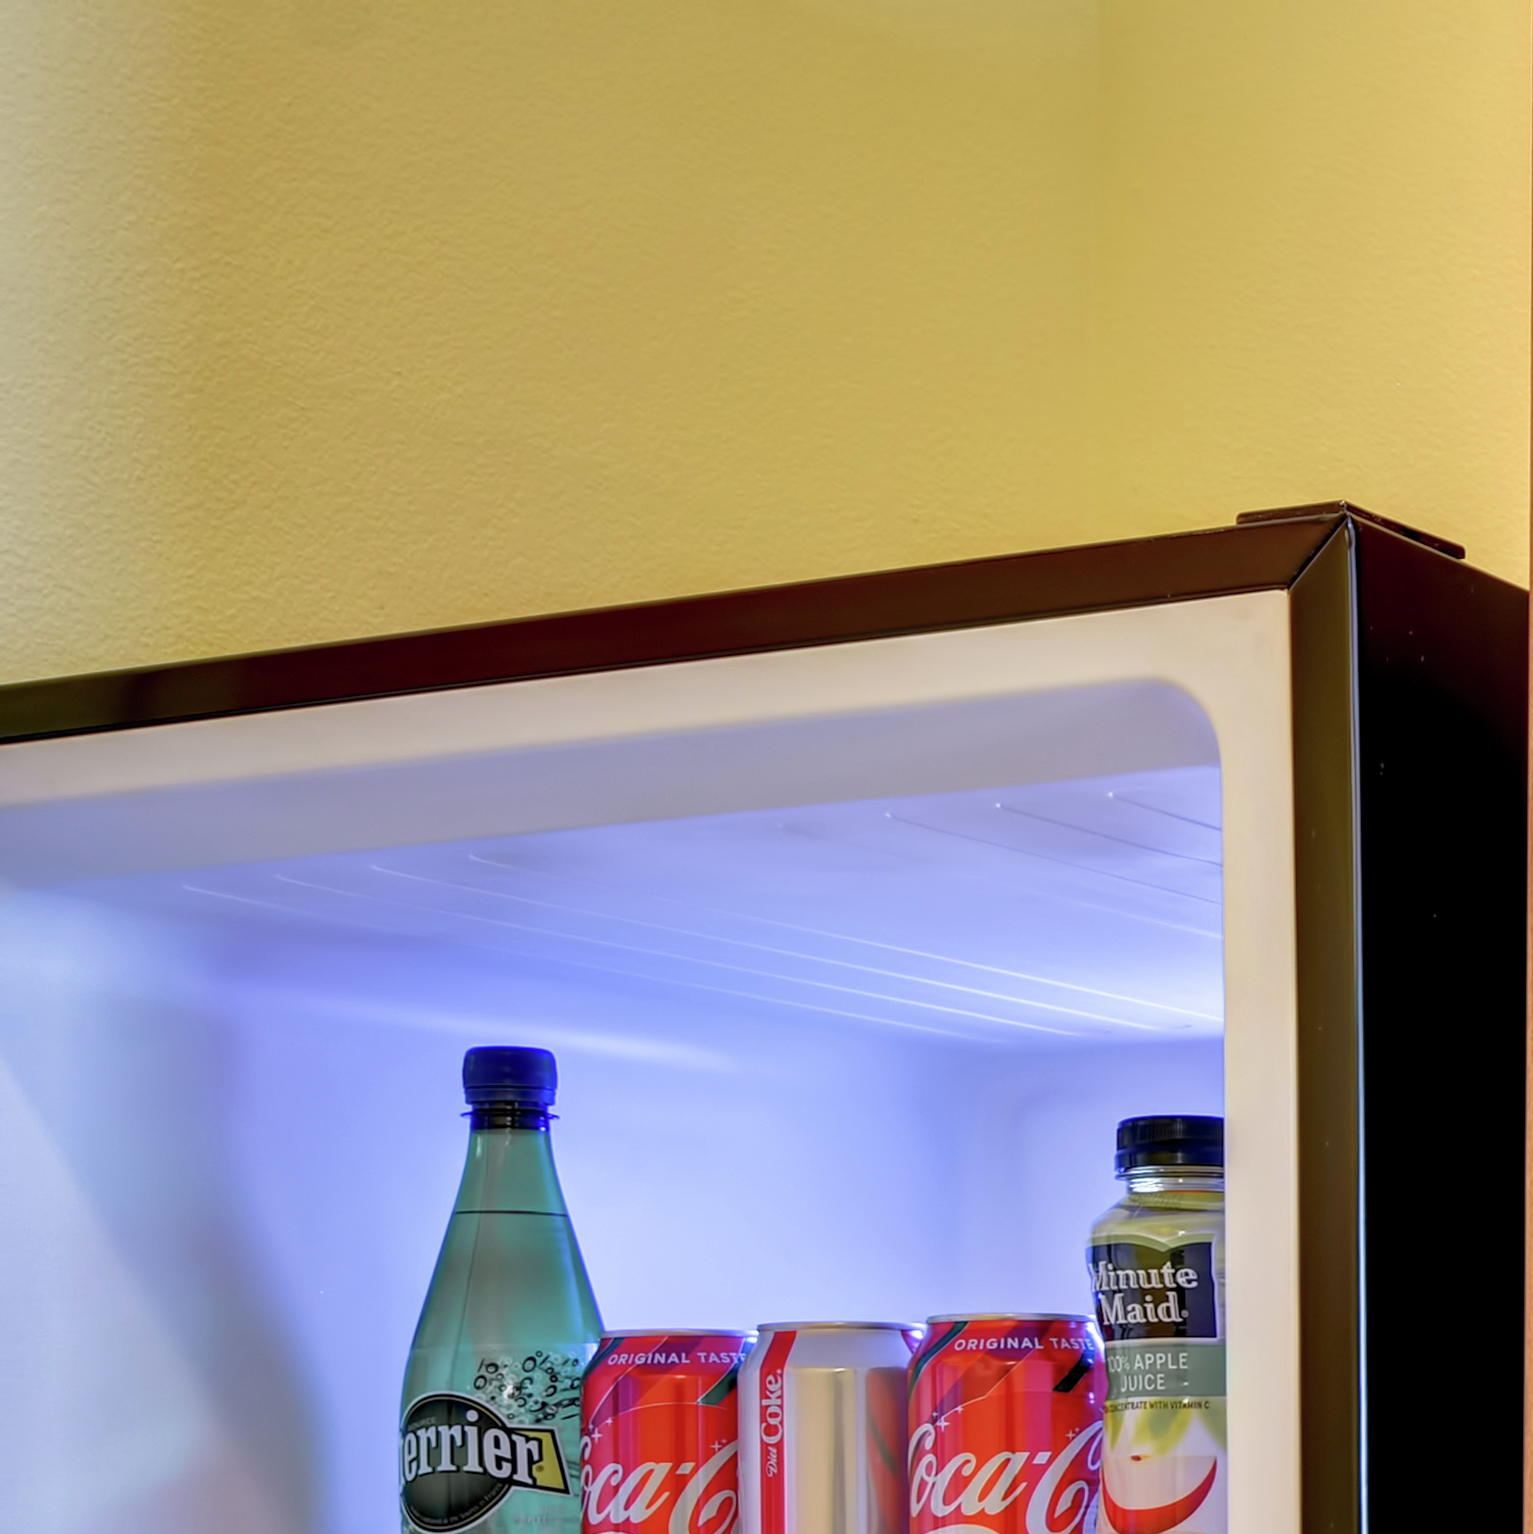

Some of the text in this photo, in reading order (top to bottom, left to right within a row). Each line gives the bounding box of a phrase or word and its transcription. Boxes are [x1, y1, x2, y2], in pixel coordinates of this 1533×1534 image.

[1089, 1261, 1198, 1291] Minute
[1101, 1292, 1184, 1325] Maid
[954, 1337, 1094, 1351] ORIGINAL TASTE
[607, 1352, 690, 1366] ORIGINAL
[1134, 1353, 1188, 1370] APPLE
[1121, 1374, 1166, 1392] JUICE
[1149, 1401, 1169, 1410] WITH
[1171, 1400, 1202, 1410] VITAMIN
[761, 1374, 783, 1478] Diet Coke
[399, 1409, 540, 1486] errier
